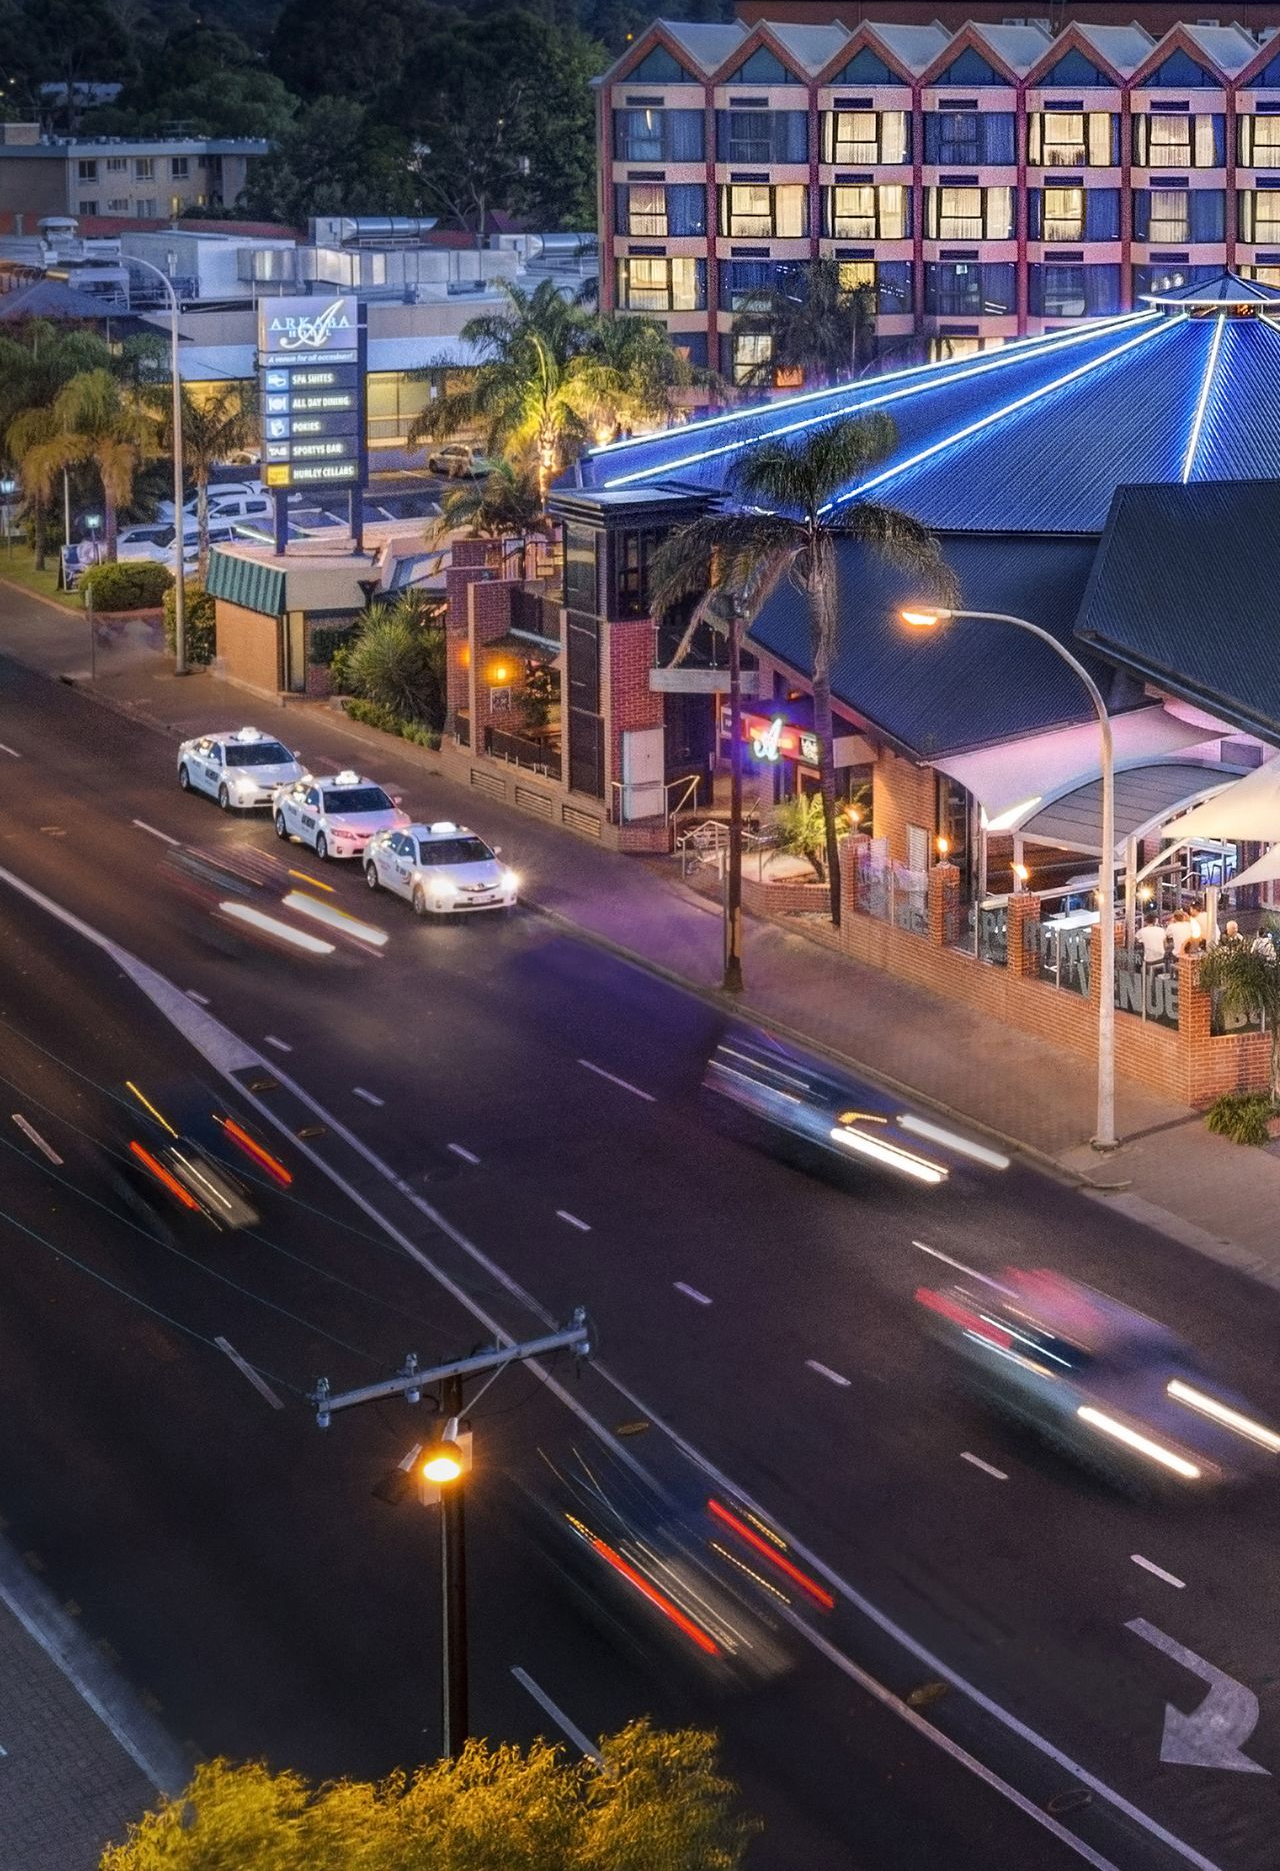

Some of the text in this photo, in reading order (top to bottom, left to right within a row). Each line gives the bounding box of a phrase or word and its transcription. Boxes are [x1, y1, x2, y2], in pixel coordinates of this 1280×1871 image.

[271, 315, 350, 330] ARKABA
[289, 329, 331, 337] HOL
[292, 374, 307, 384] SPA
[292, 396, 349, 408] ALL DAY DINING
[292, 421, 320, 432] POKIES
[293, 443, 343, 456] SPORTYS BAR
[293, 467, 322, 479] HURLEY
[323, 465, 355, 477] CELLARS
